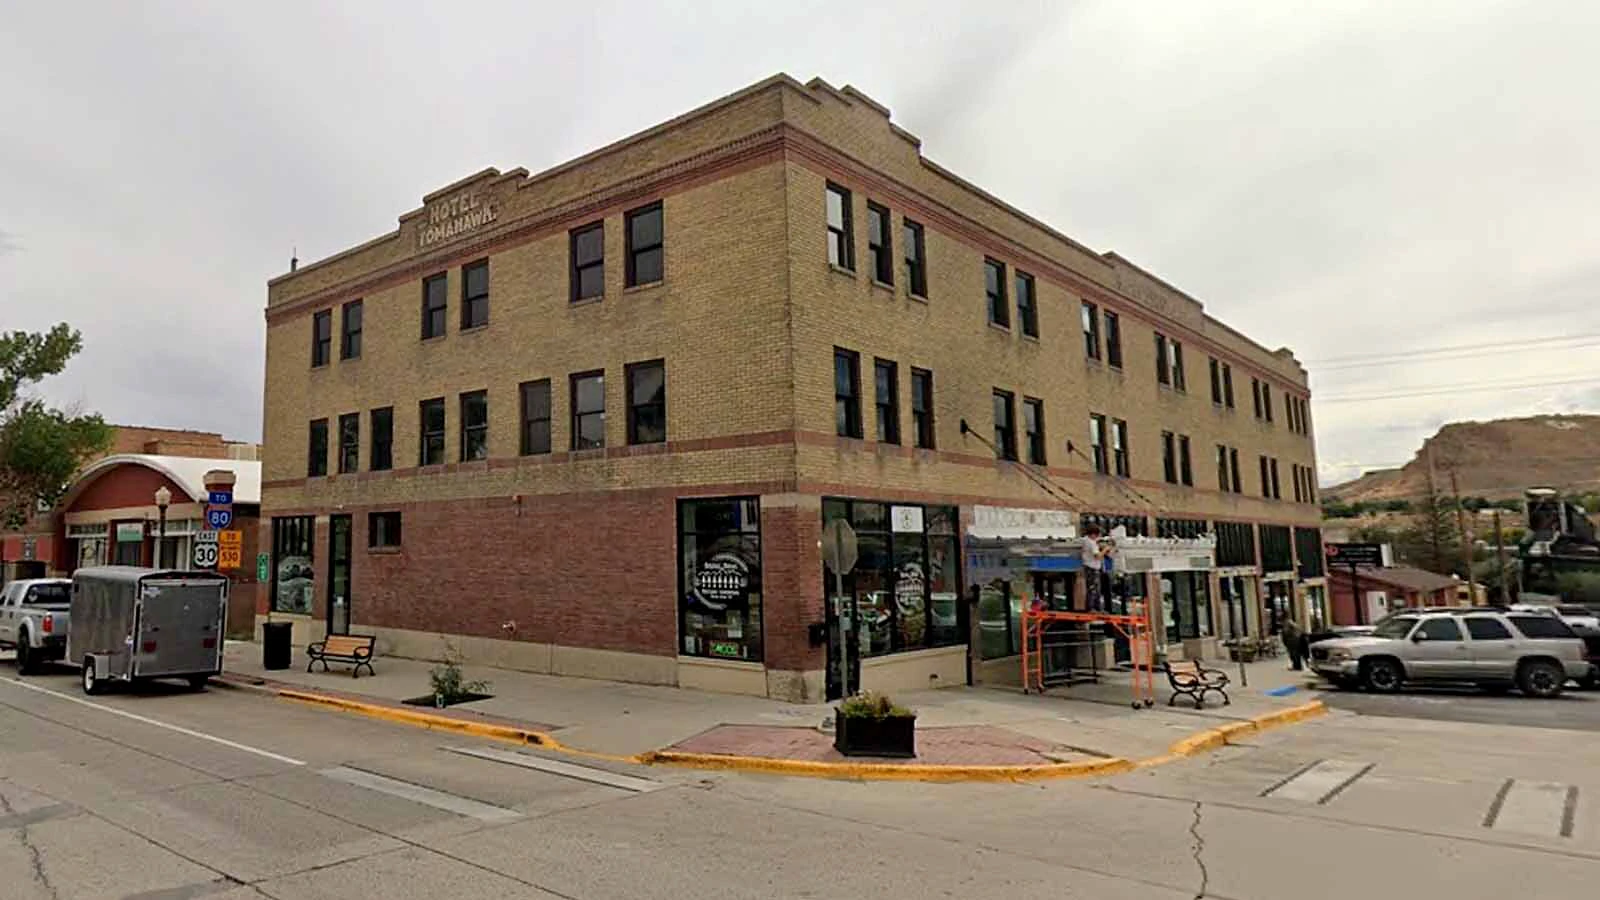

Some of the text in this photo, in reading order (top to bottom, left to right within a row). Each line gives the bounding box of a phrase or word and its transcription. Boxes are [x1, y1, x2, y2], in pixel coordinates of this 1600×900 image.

[430, 191, 480, 225] HOTEL
[215, 494, 227, 502] TO
[211, 512, 229, 525] 80
[199, 532, 216, 540] EAST
[197, 548, 216, 562] 30
